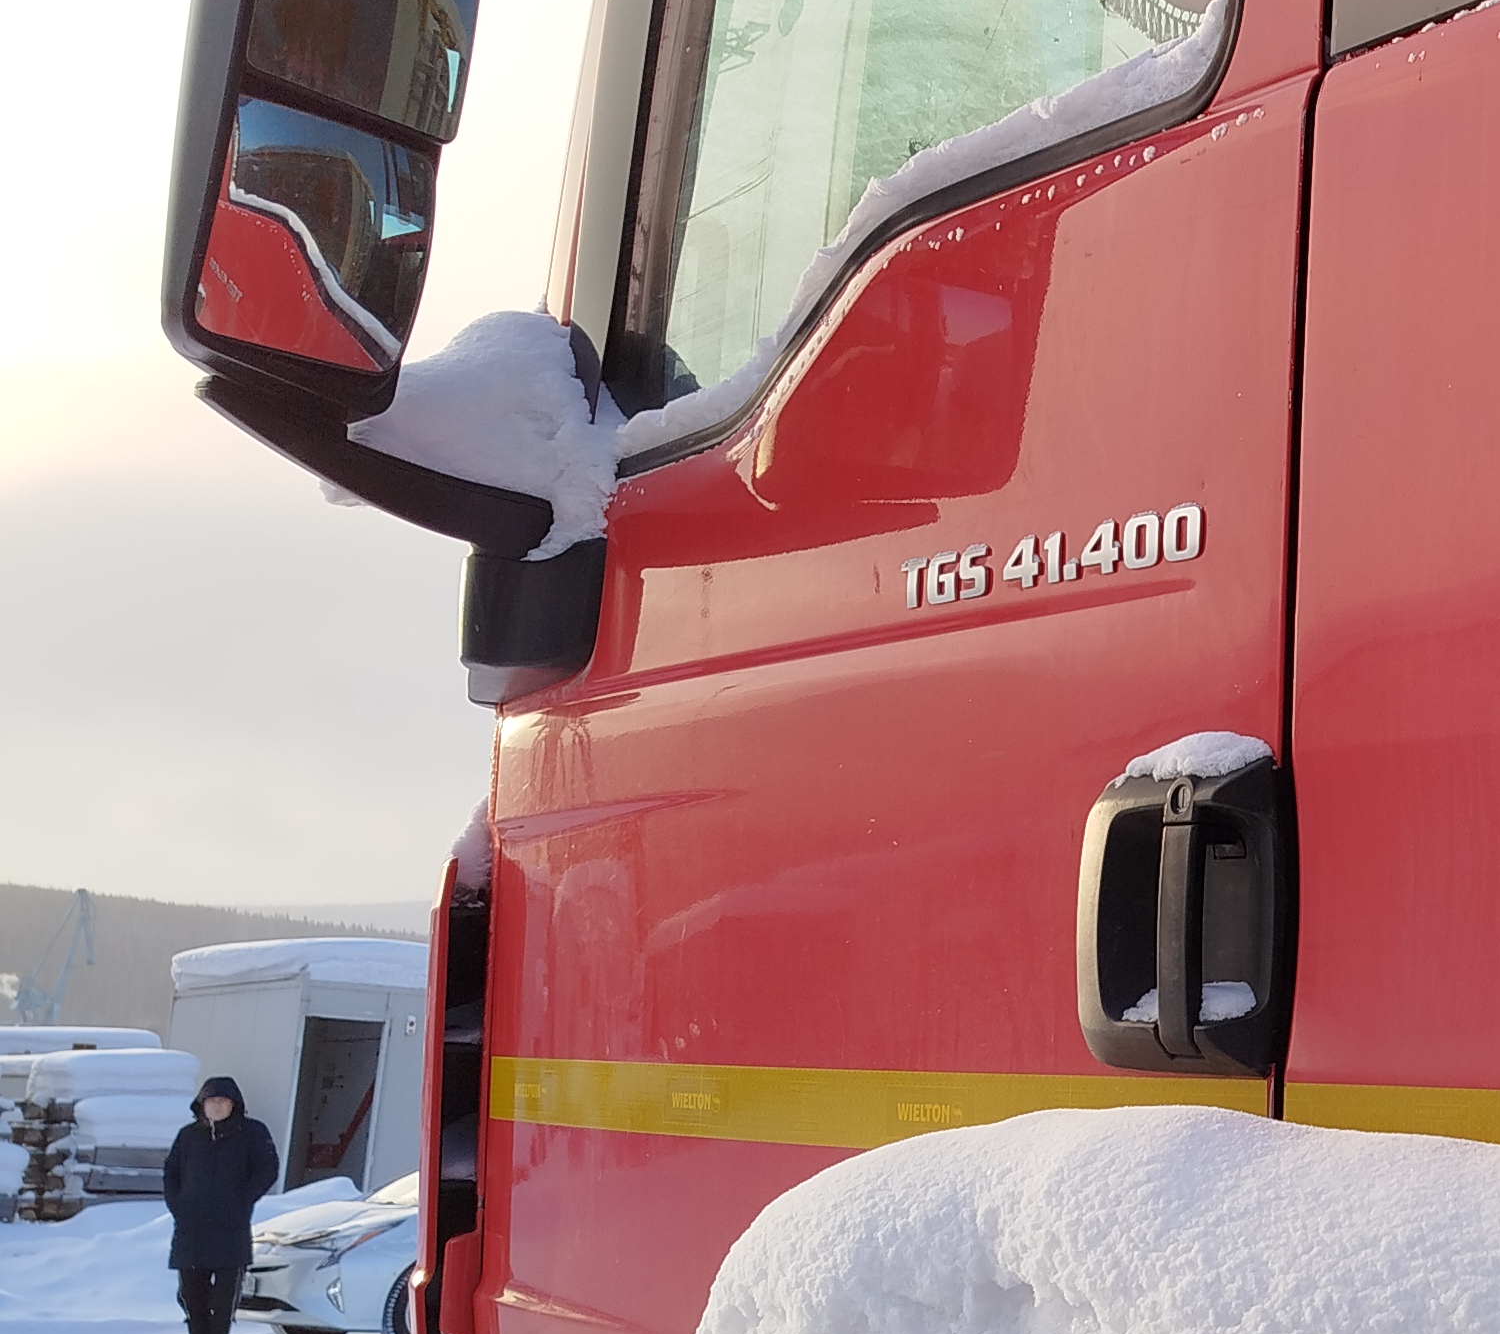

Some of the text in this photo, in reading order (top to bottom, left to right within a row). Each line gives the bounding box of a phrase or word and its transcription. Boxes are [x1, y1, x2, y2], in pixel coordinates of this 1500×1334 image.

[901, 502, 1206, 609] TGS 41.400
[671, 1092, 712, 1110] WIELTON
[897, 1103, 950, 1124] WIELTON
